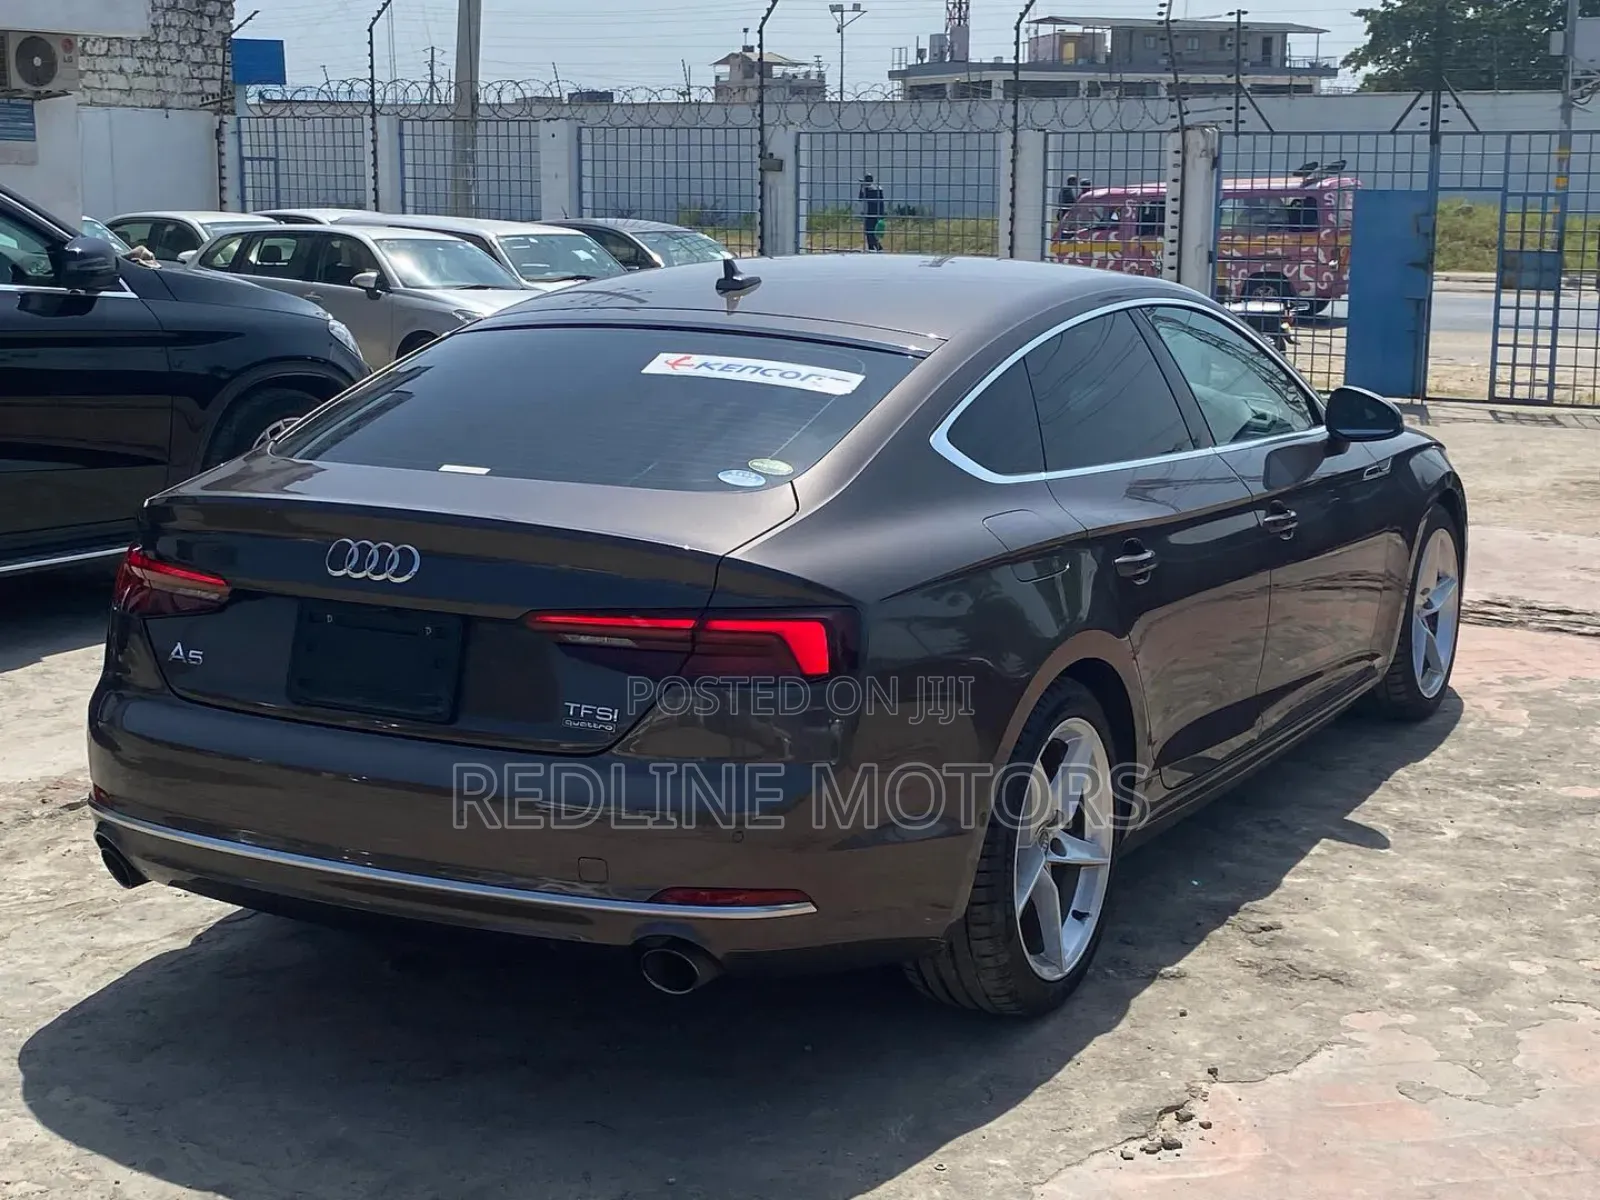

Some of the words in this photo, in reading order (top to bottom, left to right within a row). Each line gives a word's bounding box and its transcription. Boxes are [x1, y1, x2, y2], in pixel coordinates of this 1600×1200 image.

[63, 55, 73, 63] LG
[168, 641, 203, 665] A5
[564, 702, 619, 722] TFSI
[564, 719, 613, 732] quattro
